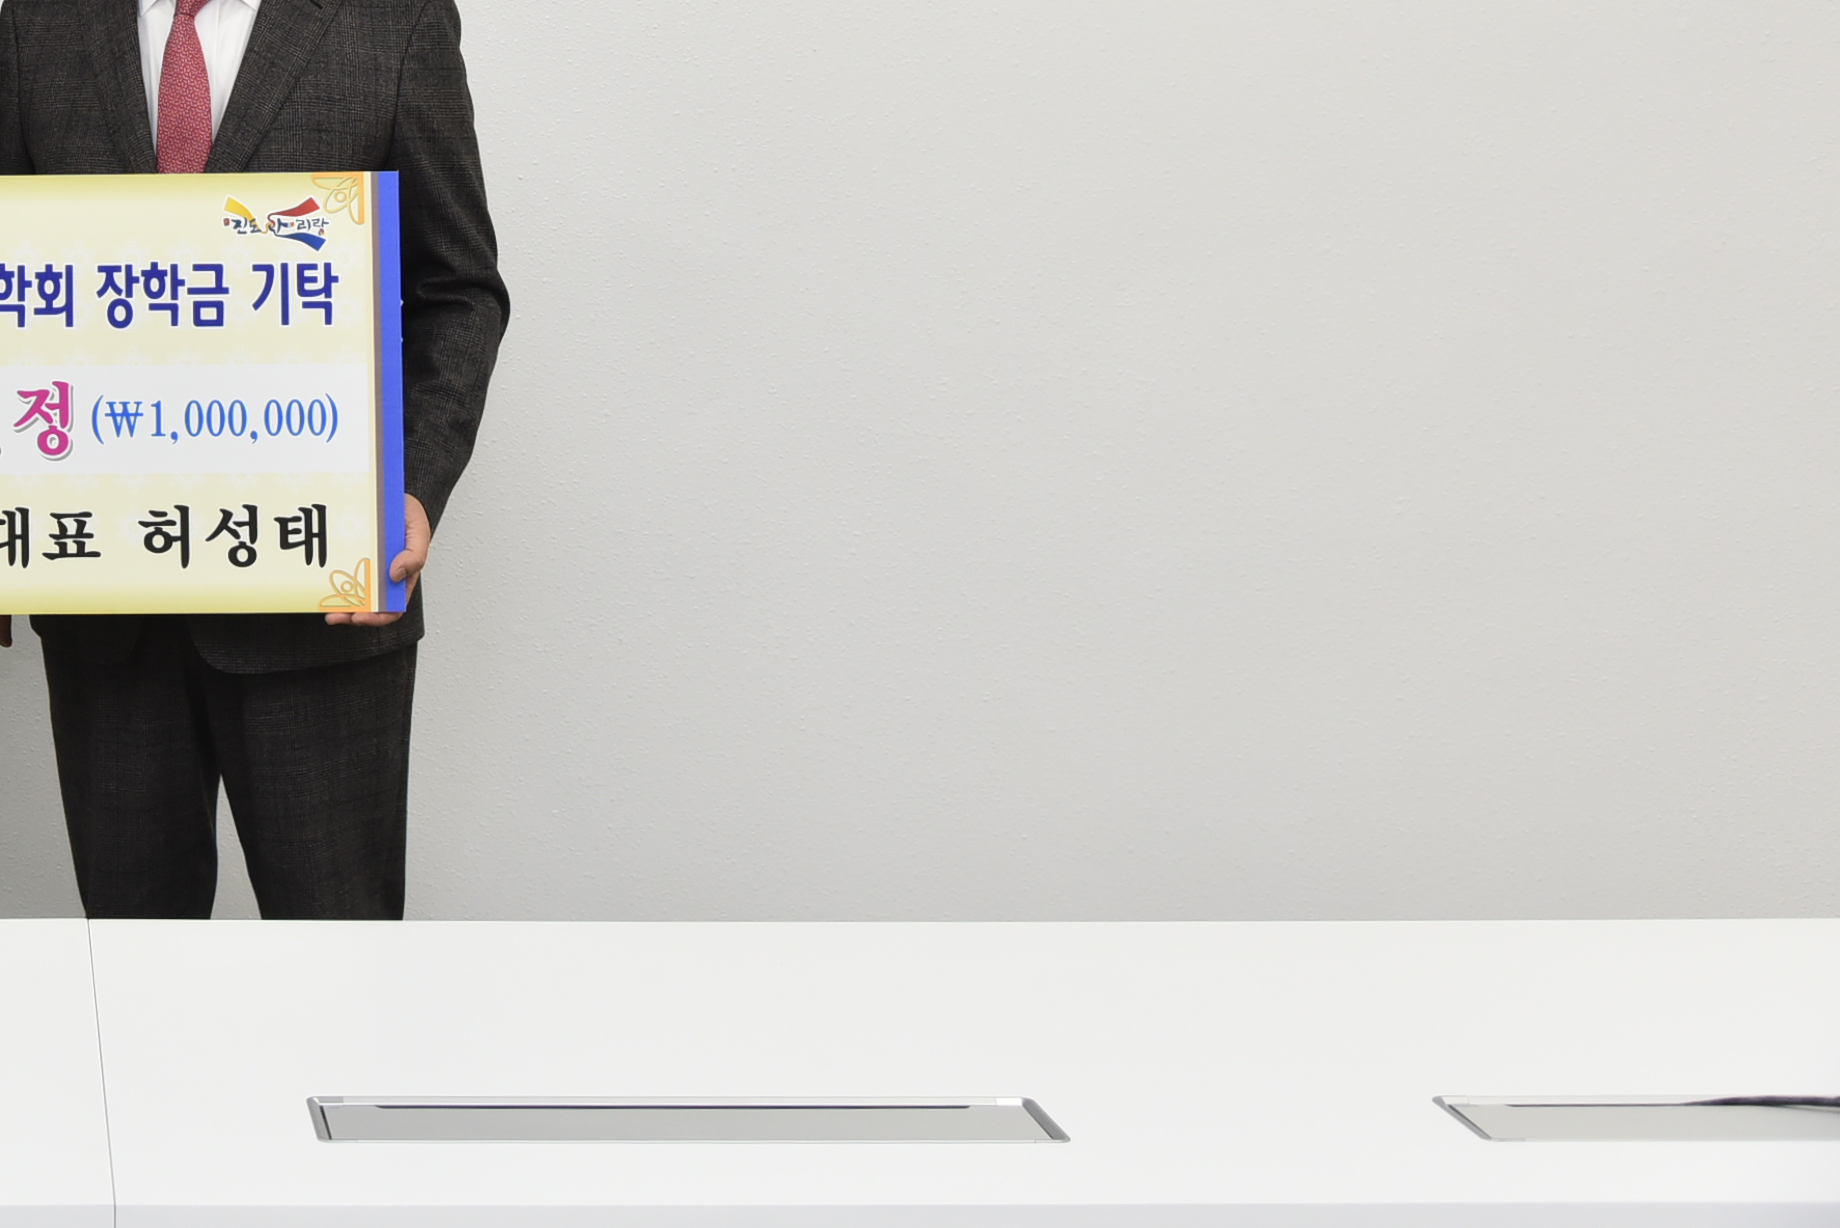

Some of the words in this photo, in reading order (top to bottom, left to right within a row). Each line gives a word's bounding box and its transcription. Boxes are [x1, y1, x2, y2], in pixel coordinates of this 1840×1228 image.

[97, 262, 231, 330] 장학금
[252, 262, 340, 328] 기탁
[91, 394, 340, 445] (₩1,000,000)
[137, 503, 331, 569] 허성태
